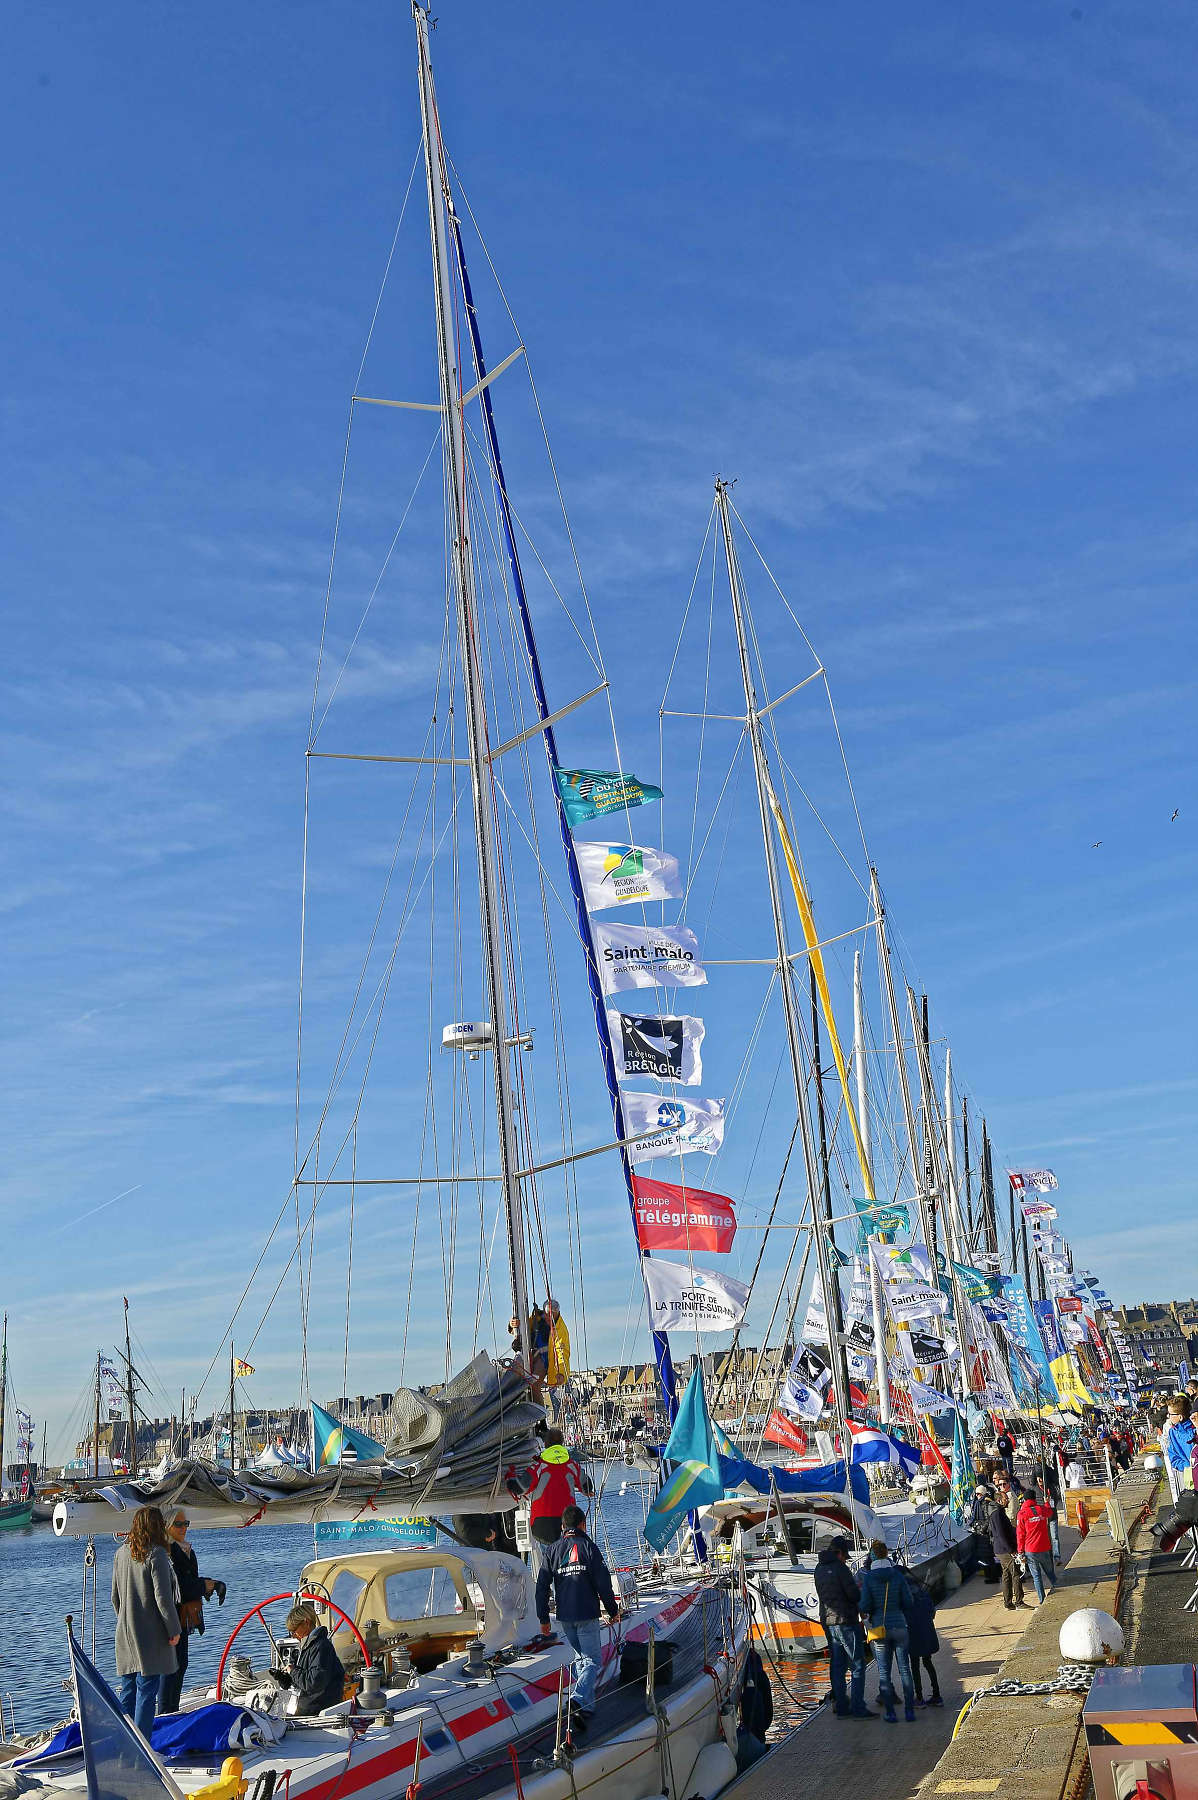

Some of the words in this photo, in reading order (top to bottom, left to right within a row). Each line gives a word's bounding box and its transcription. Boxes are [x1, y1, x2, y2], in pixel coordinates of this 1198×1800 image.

[595, 790, 645, 809] GUADELOUPE
[604, 945, 694, 962] Saint-malo
[613, 964, 657, 975] PARTENAIRE
[658, 963, 691, 972] PREMIUM
[635, 1137, 674, 1151] BANQUE
[637, 1197, 670, 1207] groupe
[637, 1209, 733, 1227] Télégramme
[681, 1291, 706, 1303] PORT
[708, 1296, 718, 1304] DE
[655, 1302, 668, 1311] LA
[1015, 1289, 1029, 1333] OCEANS
